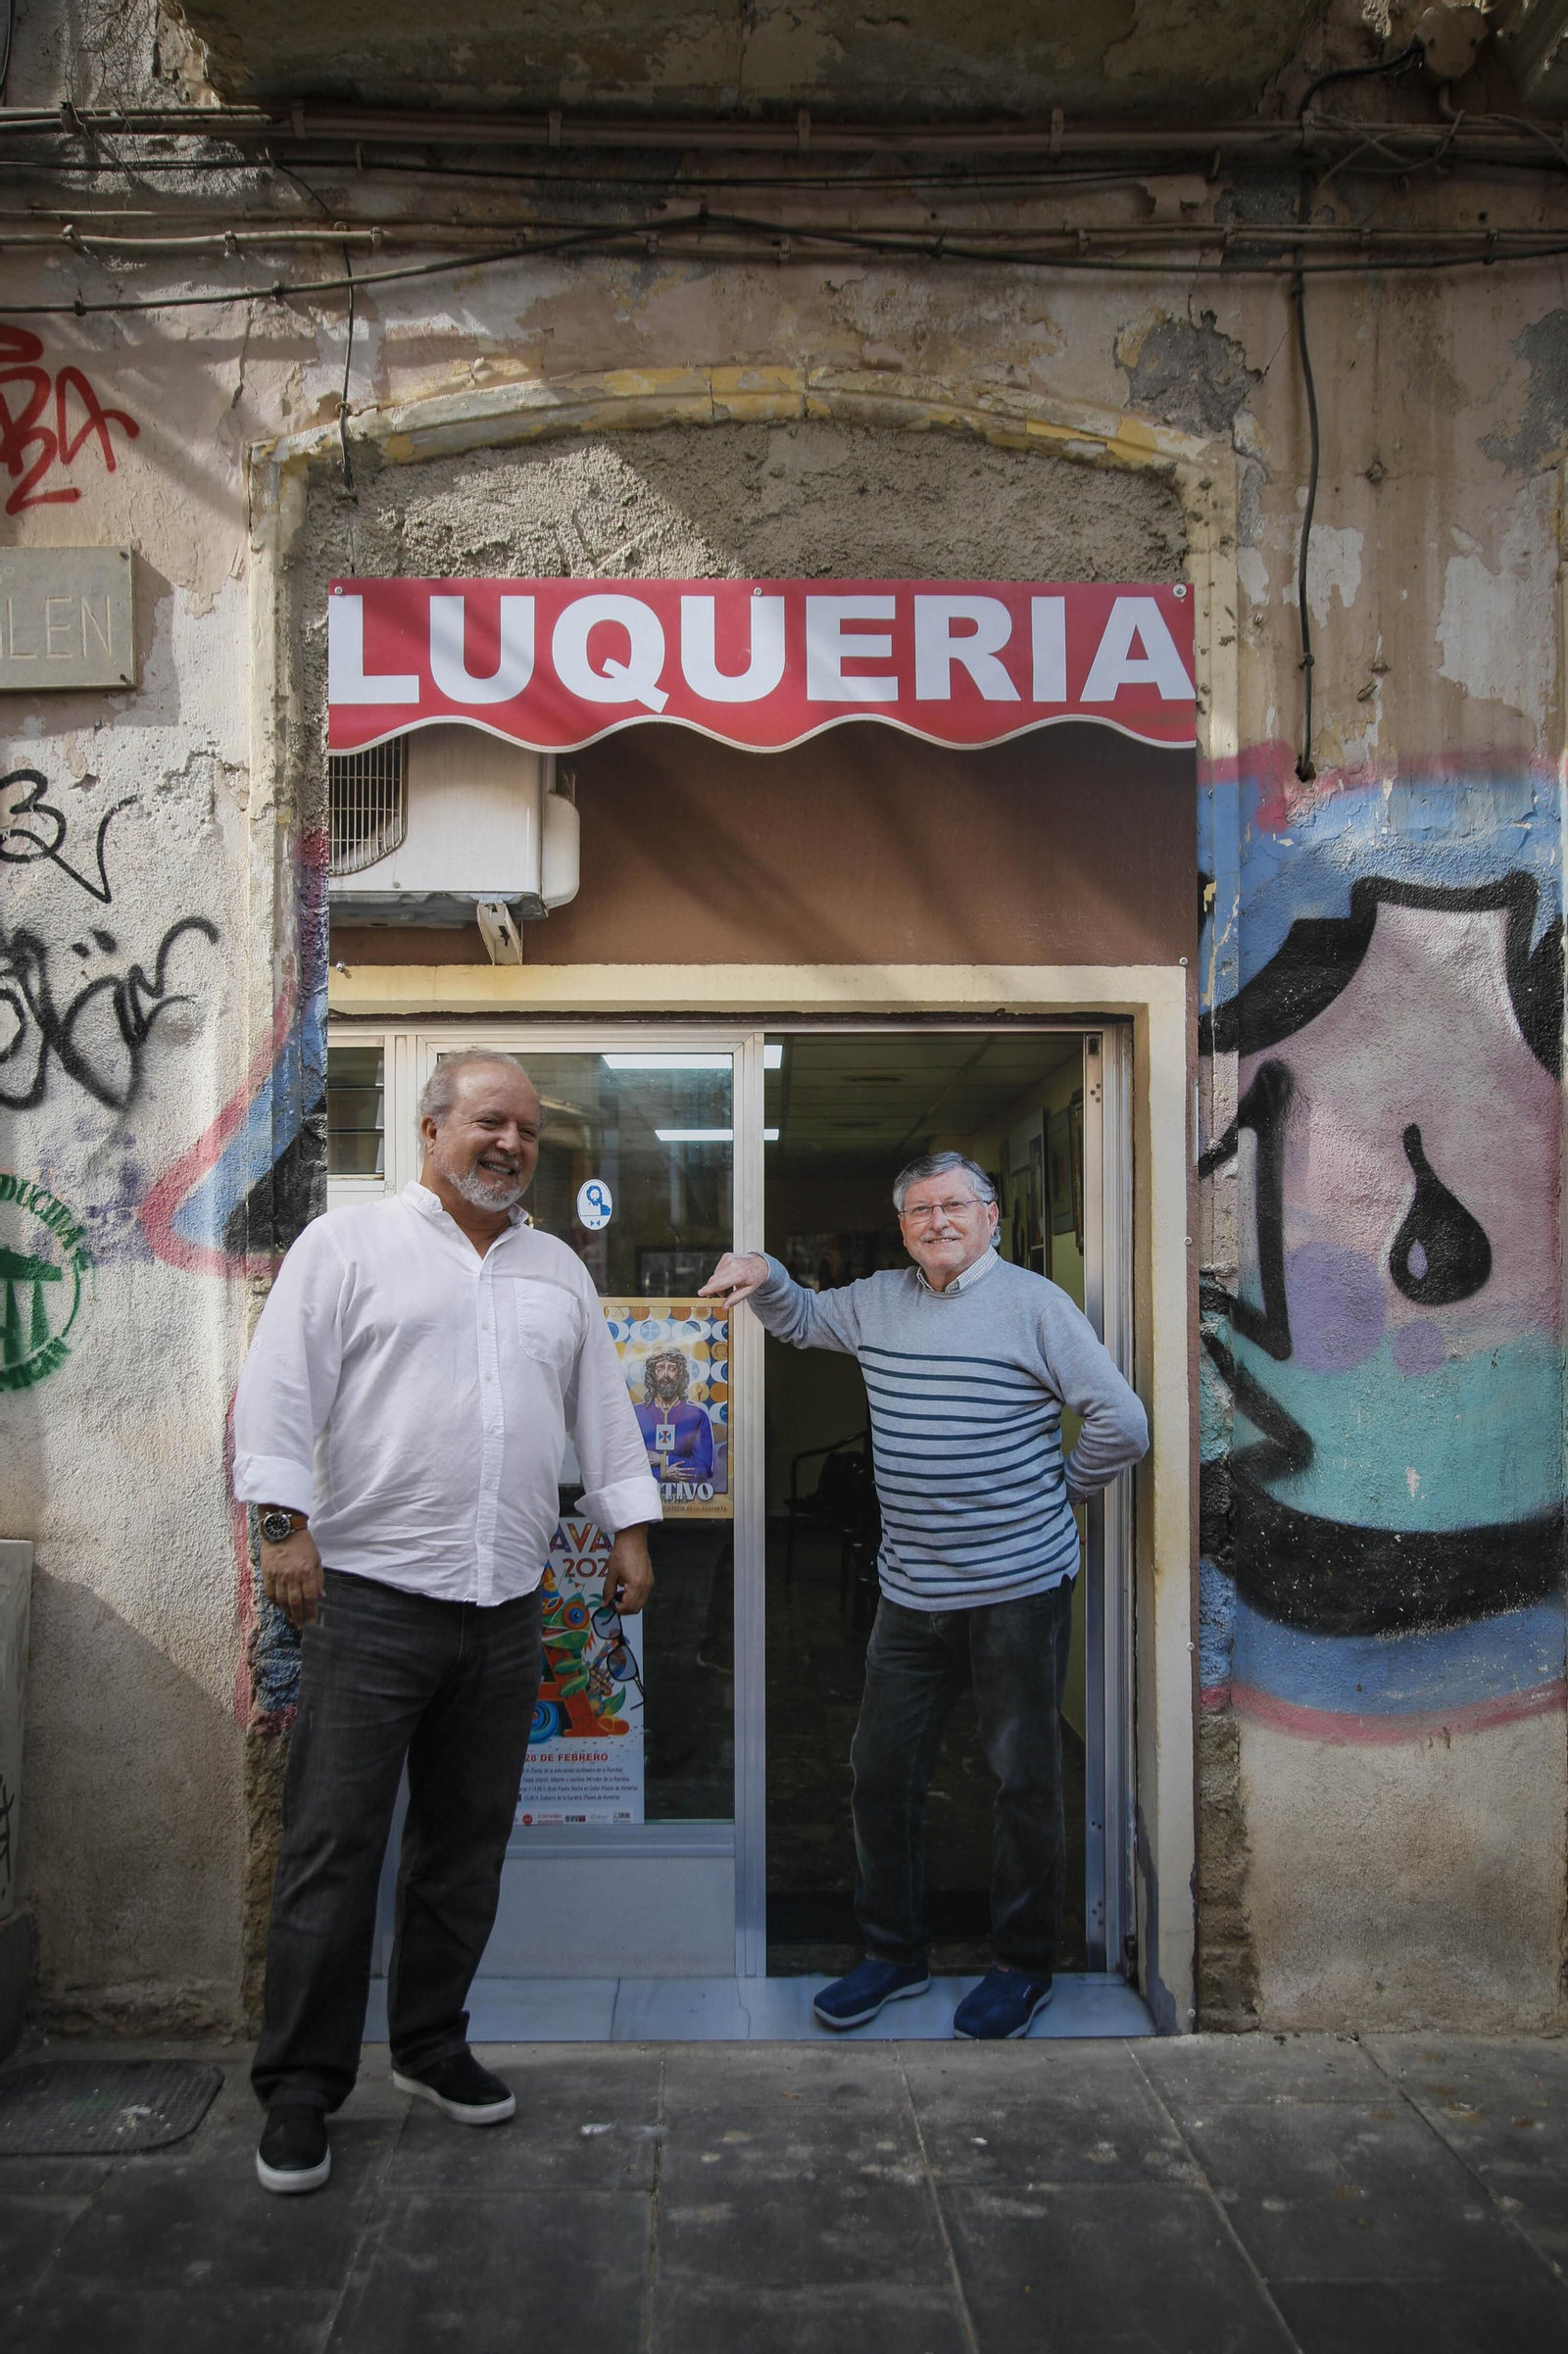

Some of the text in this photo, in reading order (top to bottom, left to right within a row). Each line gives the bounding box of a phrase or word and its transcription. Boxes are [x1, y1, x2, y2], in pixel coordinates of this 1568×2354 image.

[0, 595, 112, 659] LEN
[328, 594, 1196, 713] LUQUERIA
[540, 1753, 555, 1762] DE
[558, 1752, 609, 1762] FEBRERO
